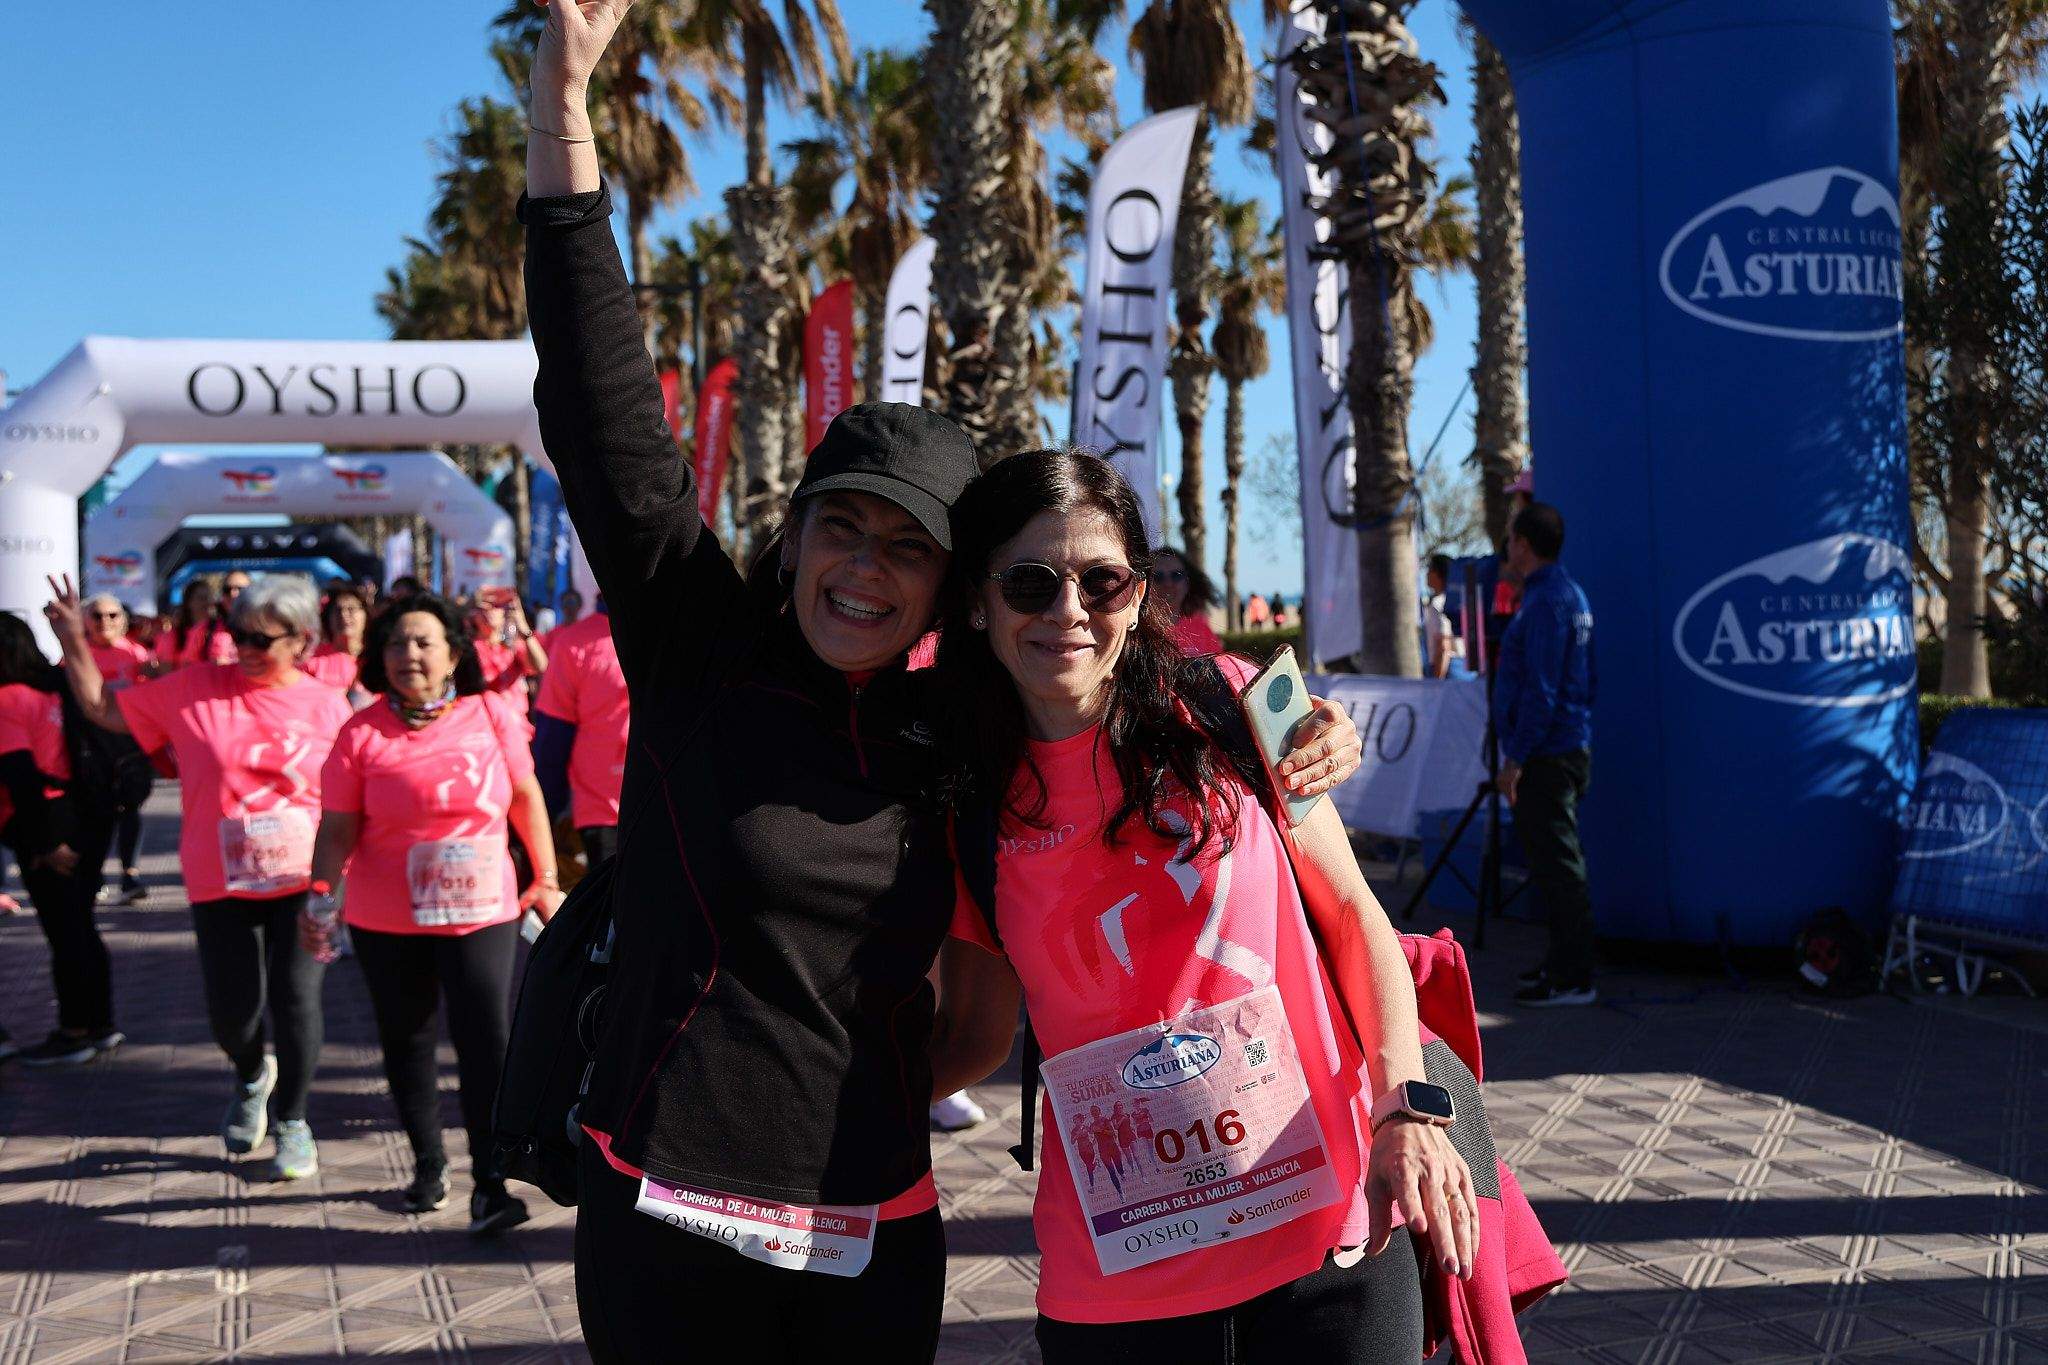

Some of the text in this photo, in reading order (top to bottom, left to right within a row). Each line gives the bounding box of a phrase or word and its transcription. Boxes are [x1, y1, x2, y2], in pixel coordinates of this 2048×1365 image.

[1747, 227, 1851, 245] CENTRAL
[1689, 233, 1904, 301] ASTURIAN
[1093, 188, 1163, 461] YSHO
[187, 361, 467, 418] OYSHO
[4, 423, 99, 443] OYSHO
[0, 534, 54, 555] SHO
[1760, 592, 1863, 612] CENTRAL
[1703, 600, 1916, 665] ASTURIAN
[1132, 1048, 1216, 1084] ASTURIANA
[1142, 1052, 1174, 1066] CENTRAL
[1065, 1083, 1077, 1091] TU
[1071, 1080, 1116, 1103] SUMA
[1154, 1109, 1246, 1164] 016
[1120, 1159, 1302, 1223] CARRERA DE LA MUJER VALENCIA
[1183, 1162, 1227, 1187] 2653
[673, 1188, 848, 1232] CARRERA DE LA MUJER VALENCIA
[1124, 1186, 1313, 1253] OYSHO Santander
[662, 1213, 844, 1261] OYSHO Santander
